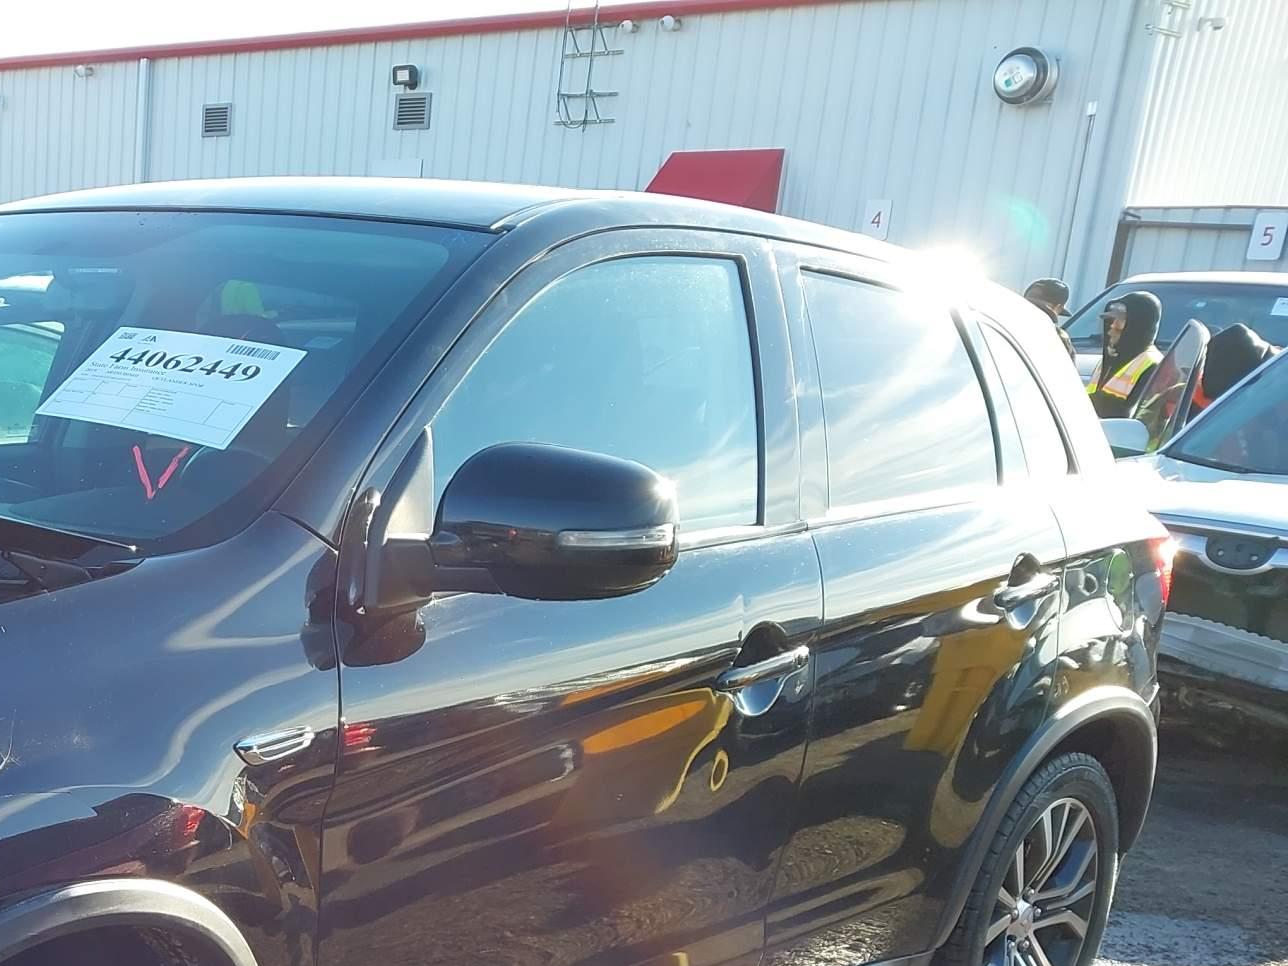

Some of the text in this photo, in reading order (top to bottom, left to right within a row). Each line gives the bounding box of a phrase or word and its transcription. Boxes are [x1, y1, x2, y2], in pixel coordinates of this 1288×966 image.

[870, 211, 882, 228] 4
[1260, 226, 1276, 246] 5
[110, 347, 261, 382] 44062449
